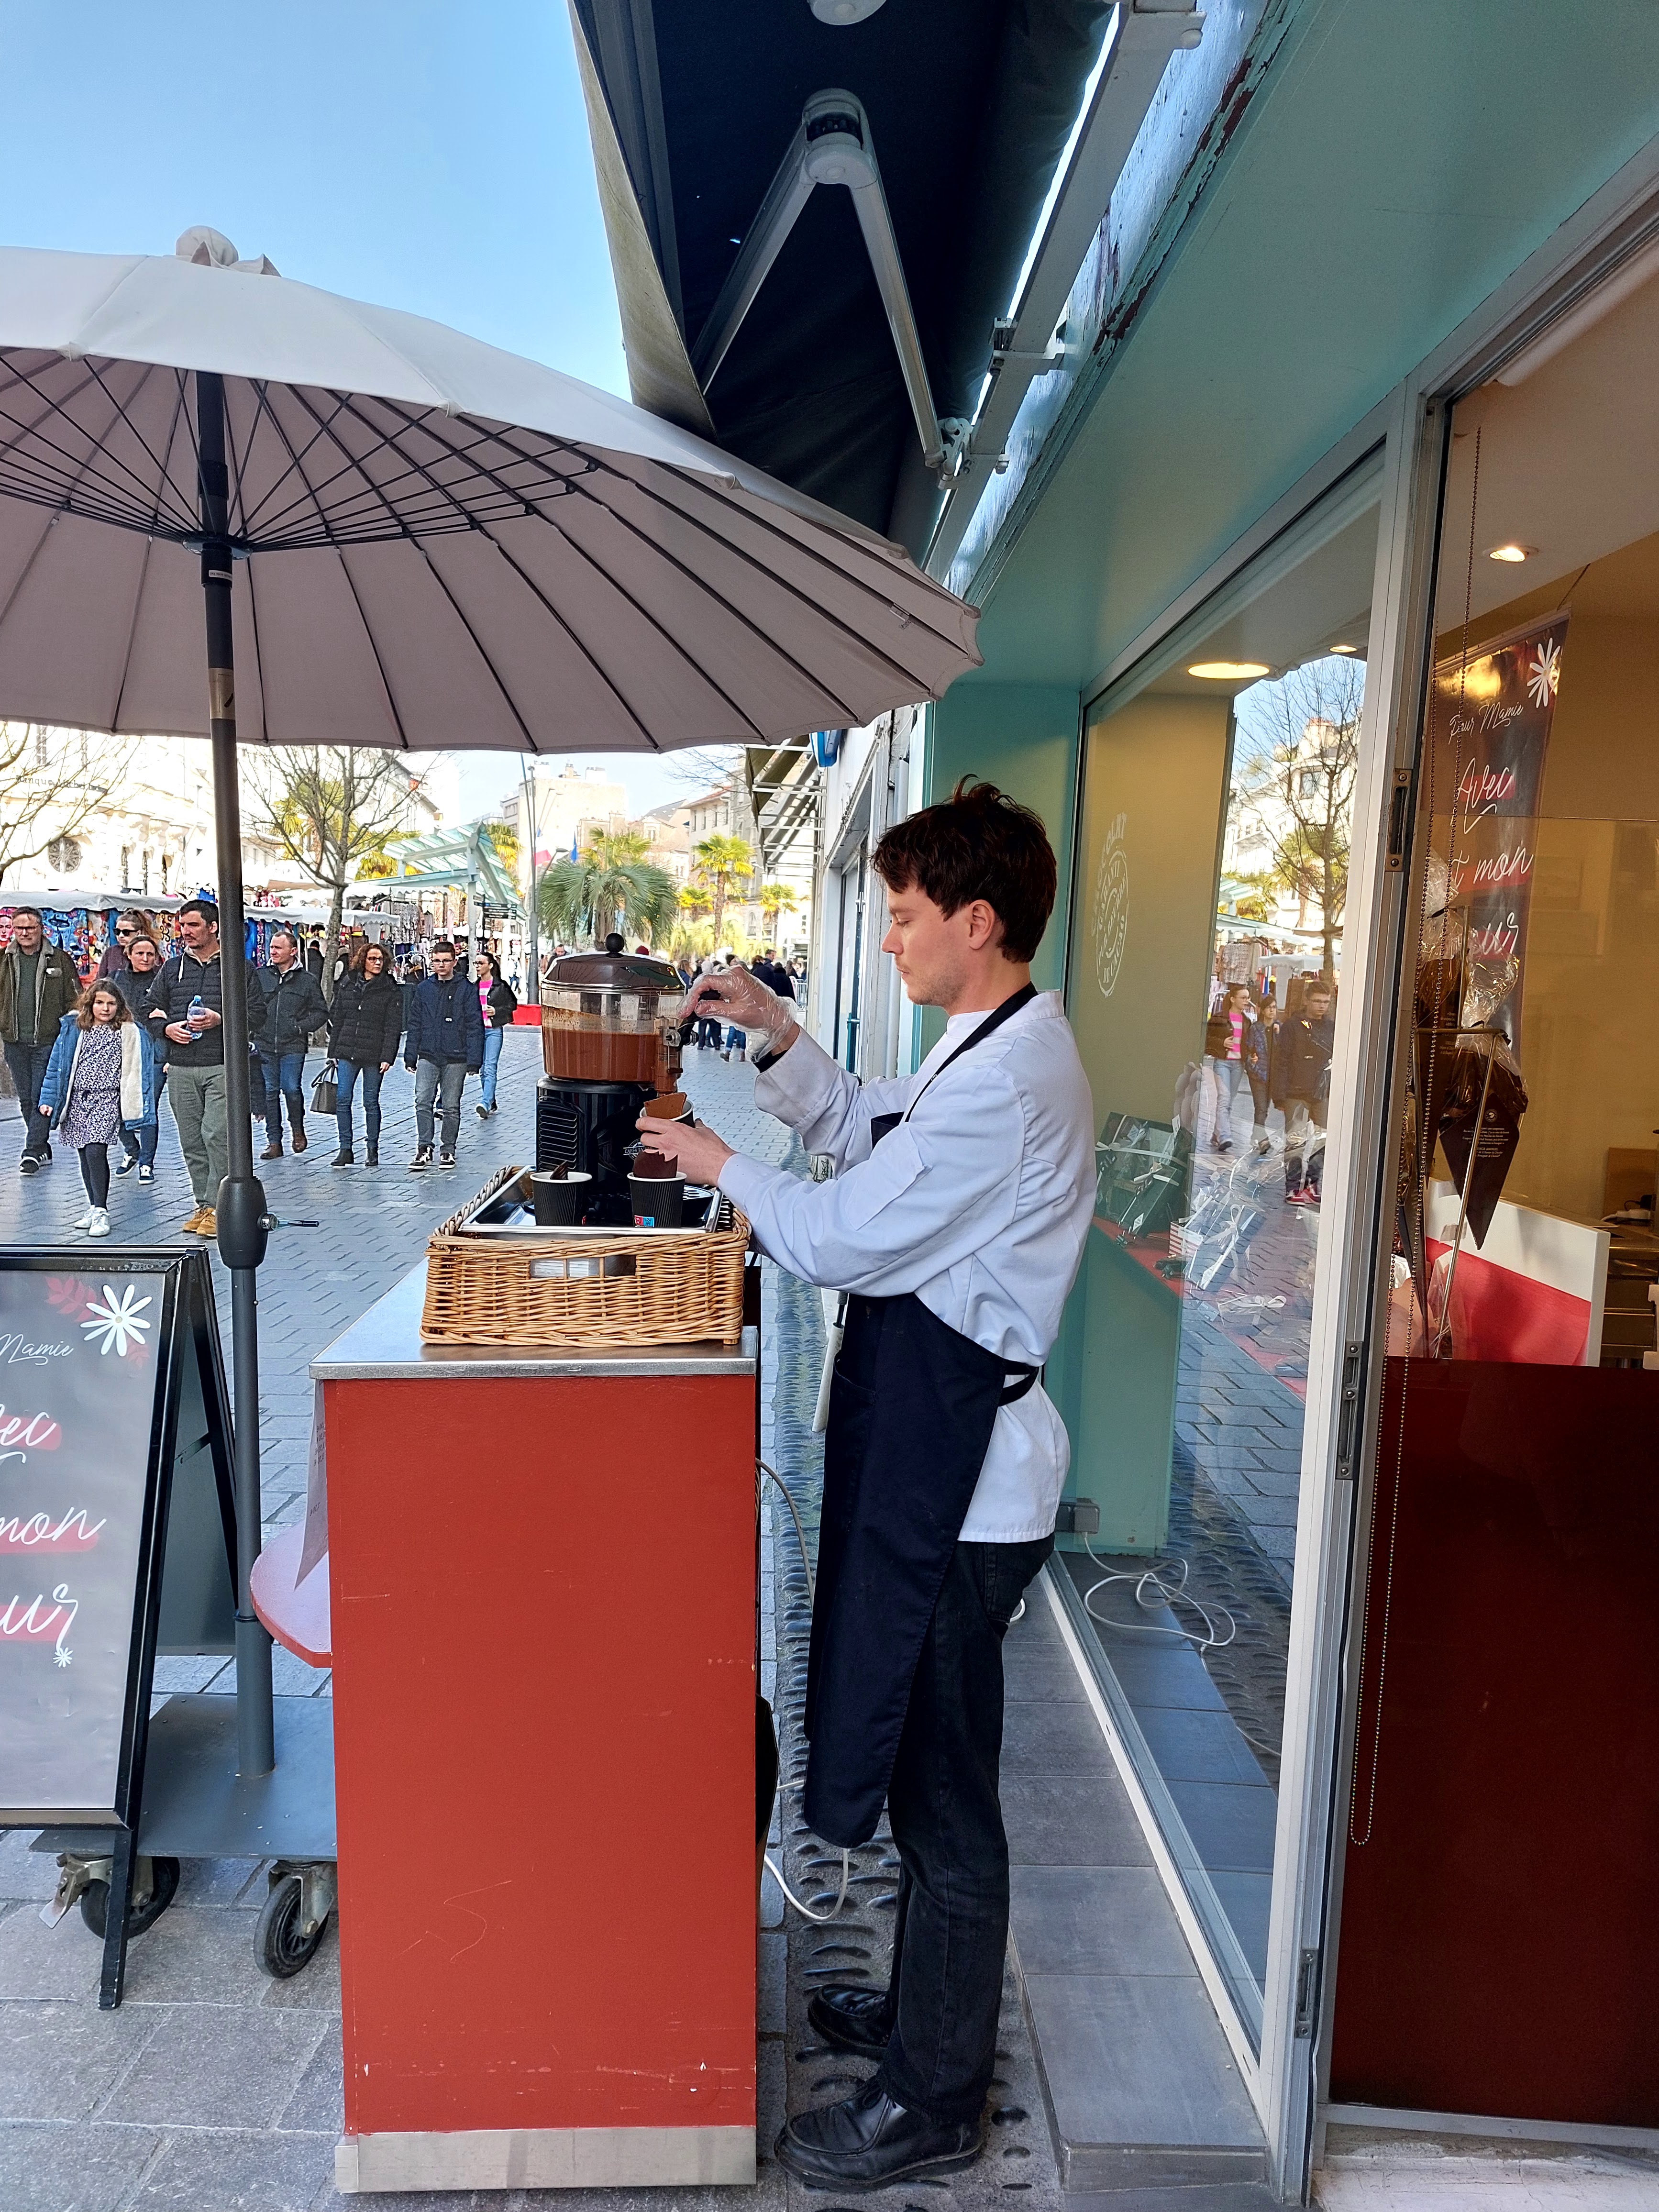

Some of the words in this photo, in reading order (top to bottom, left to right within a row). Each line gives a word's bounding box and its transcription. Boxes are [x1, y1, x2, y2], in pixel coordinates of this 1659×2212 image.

[1479, 701, 1524, 734] Mamie
[1450, 757, 1514, 834] Avec
[1473, 845, 1534, 885] mon
[1103, 967, 1110, 984] DE
[0, 1333, 74, 1366] Mamie
[0, 1583, 78, 1653] ur
